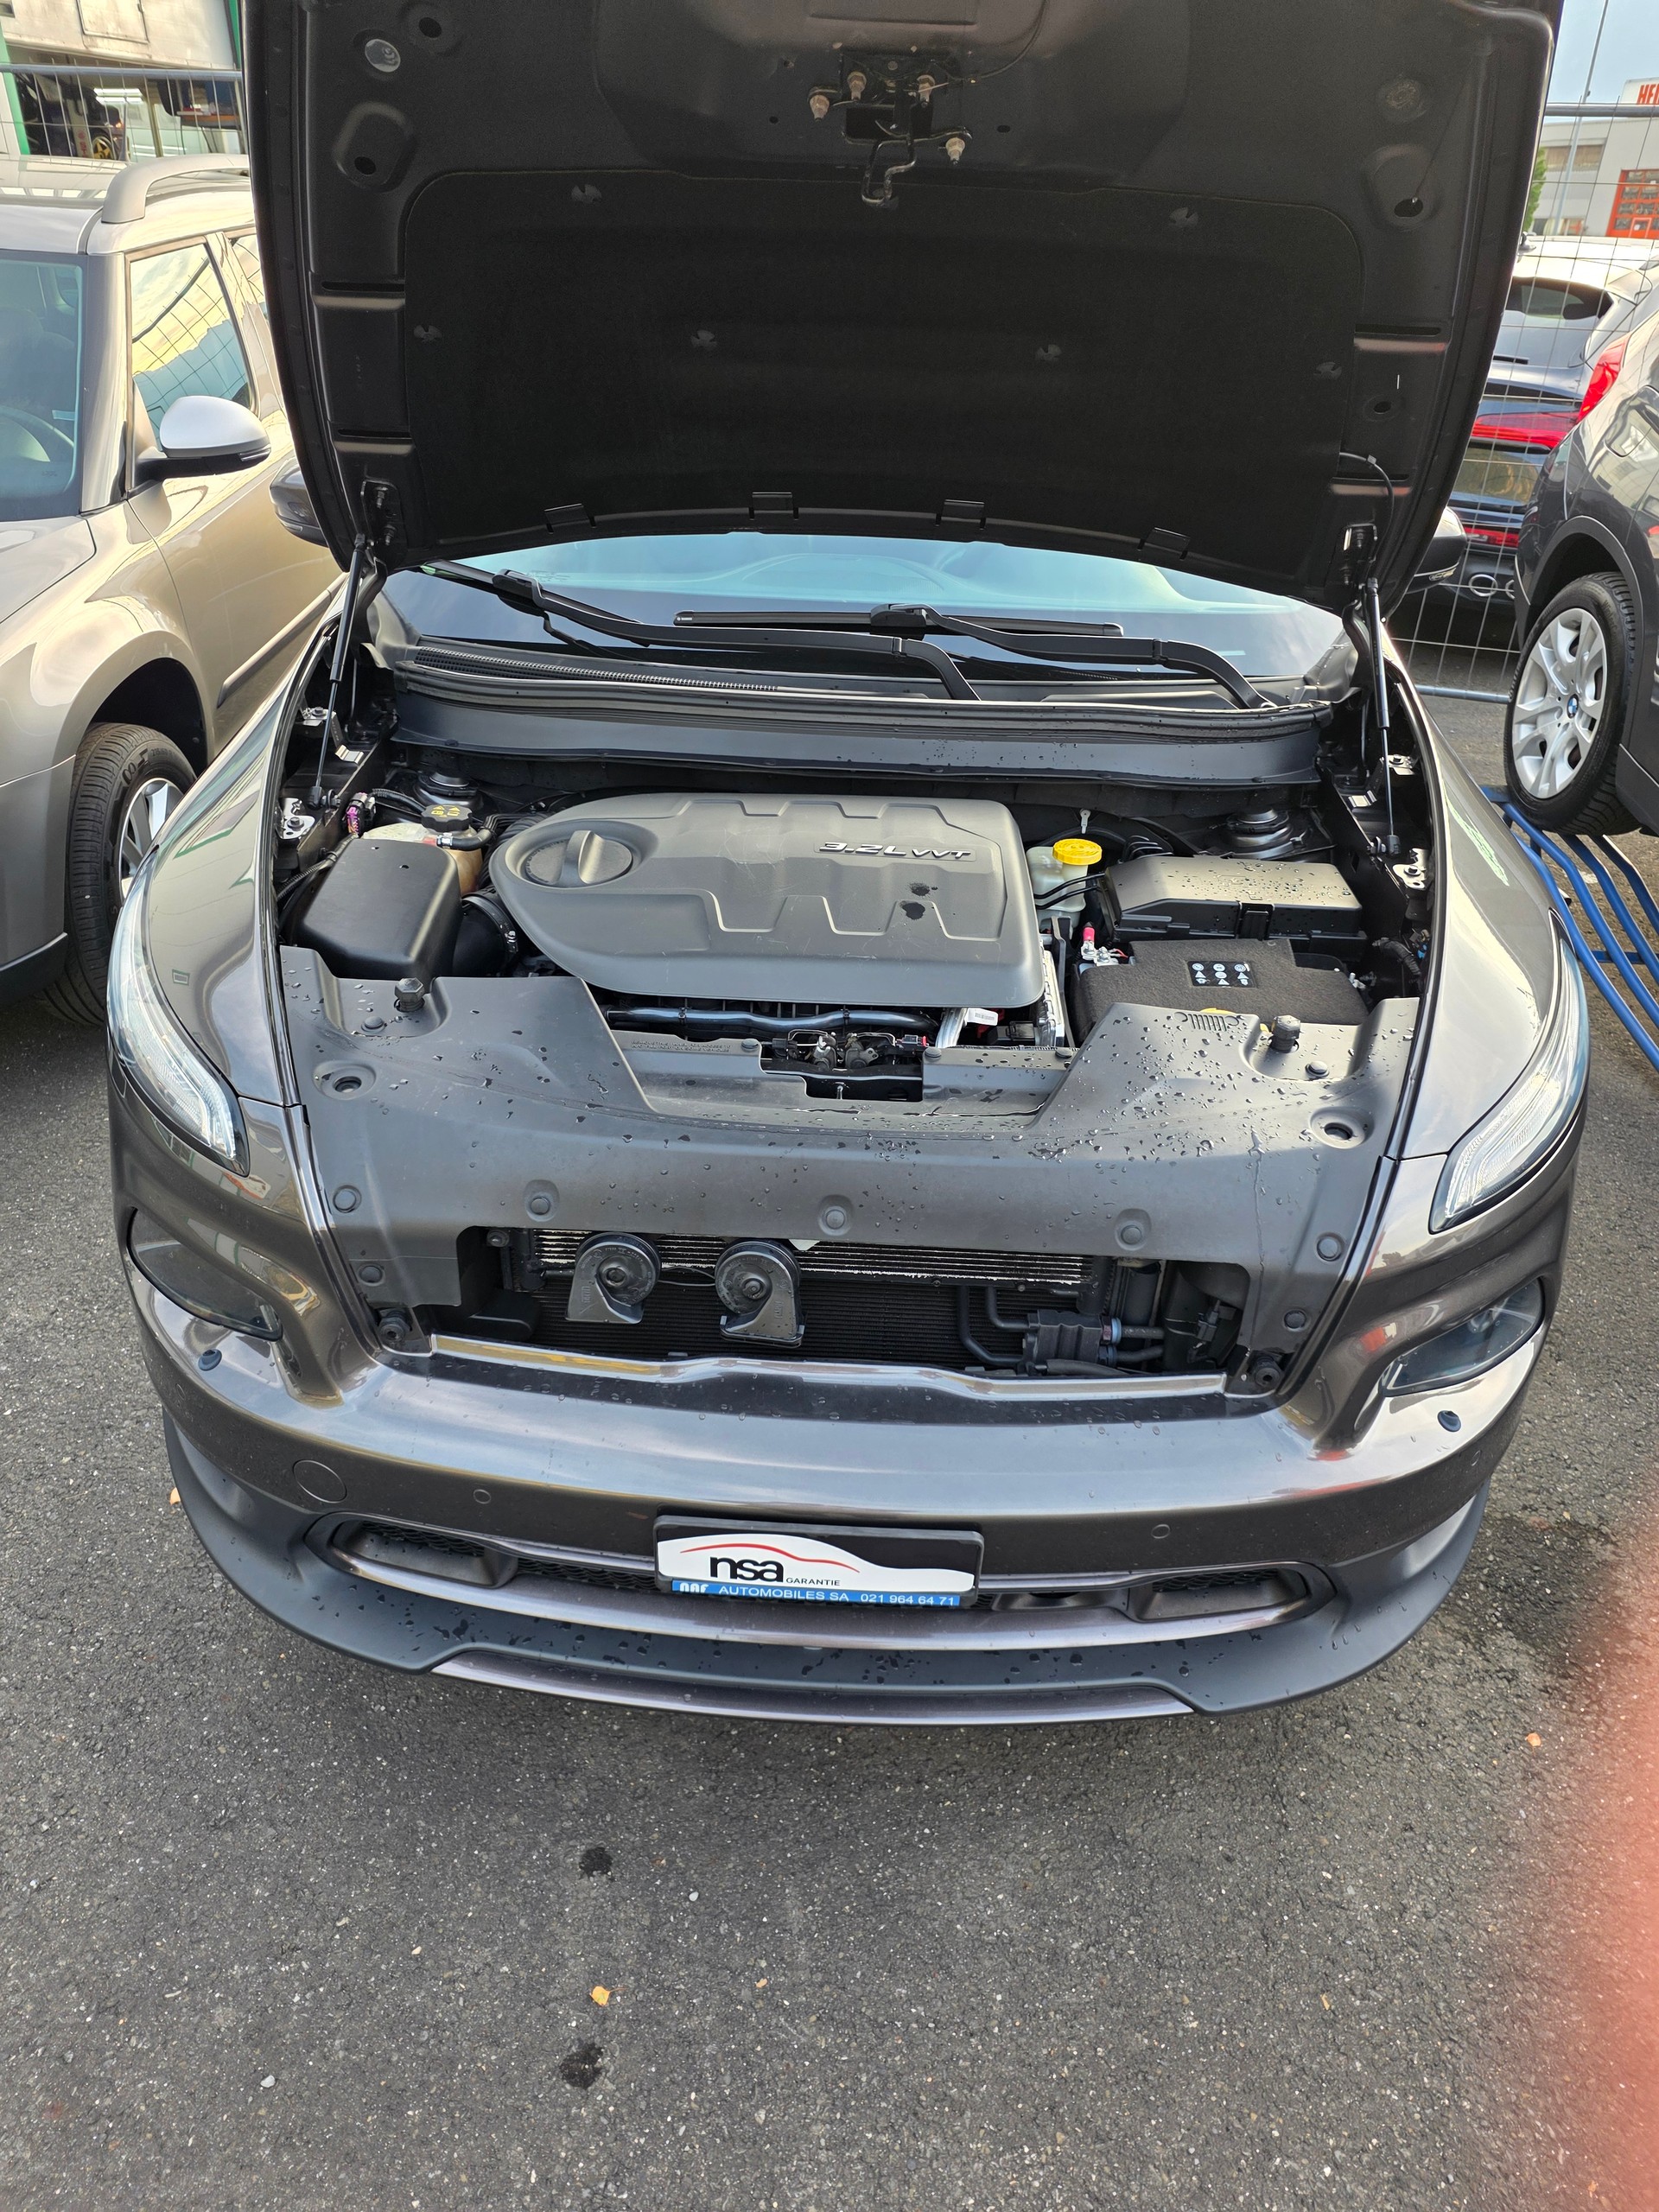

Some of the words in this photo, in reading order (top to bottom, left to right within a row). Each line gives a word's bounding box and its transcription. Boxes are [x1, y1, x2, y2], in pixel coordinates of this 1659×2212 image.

[819, 842, 906, 856] 3.2L
[912, 849, 970, 859] VVT
[710, 1556, 784, 1582] nsa
[786, 1577, 841, 1586] GARANTIE
[719, 1586, 825, 1600] AUTOMOBILES
[830, 1592, 849, 1602] SA
[861, 1593, 884, 1603] 021
[889, 1595, 913, 1605] 964
[918, 1595, 934, 1605] 64
[939, 1596, 954, 1606] 71
